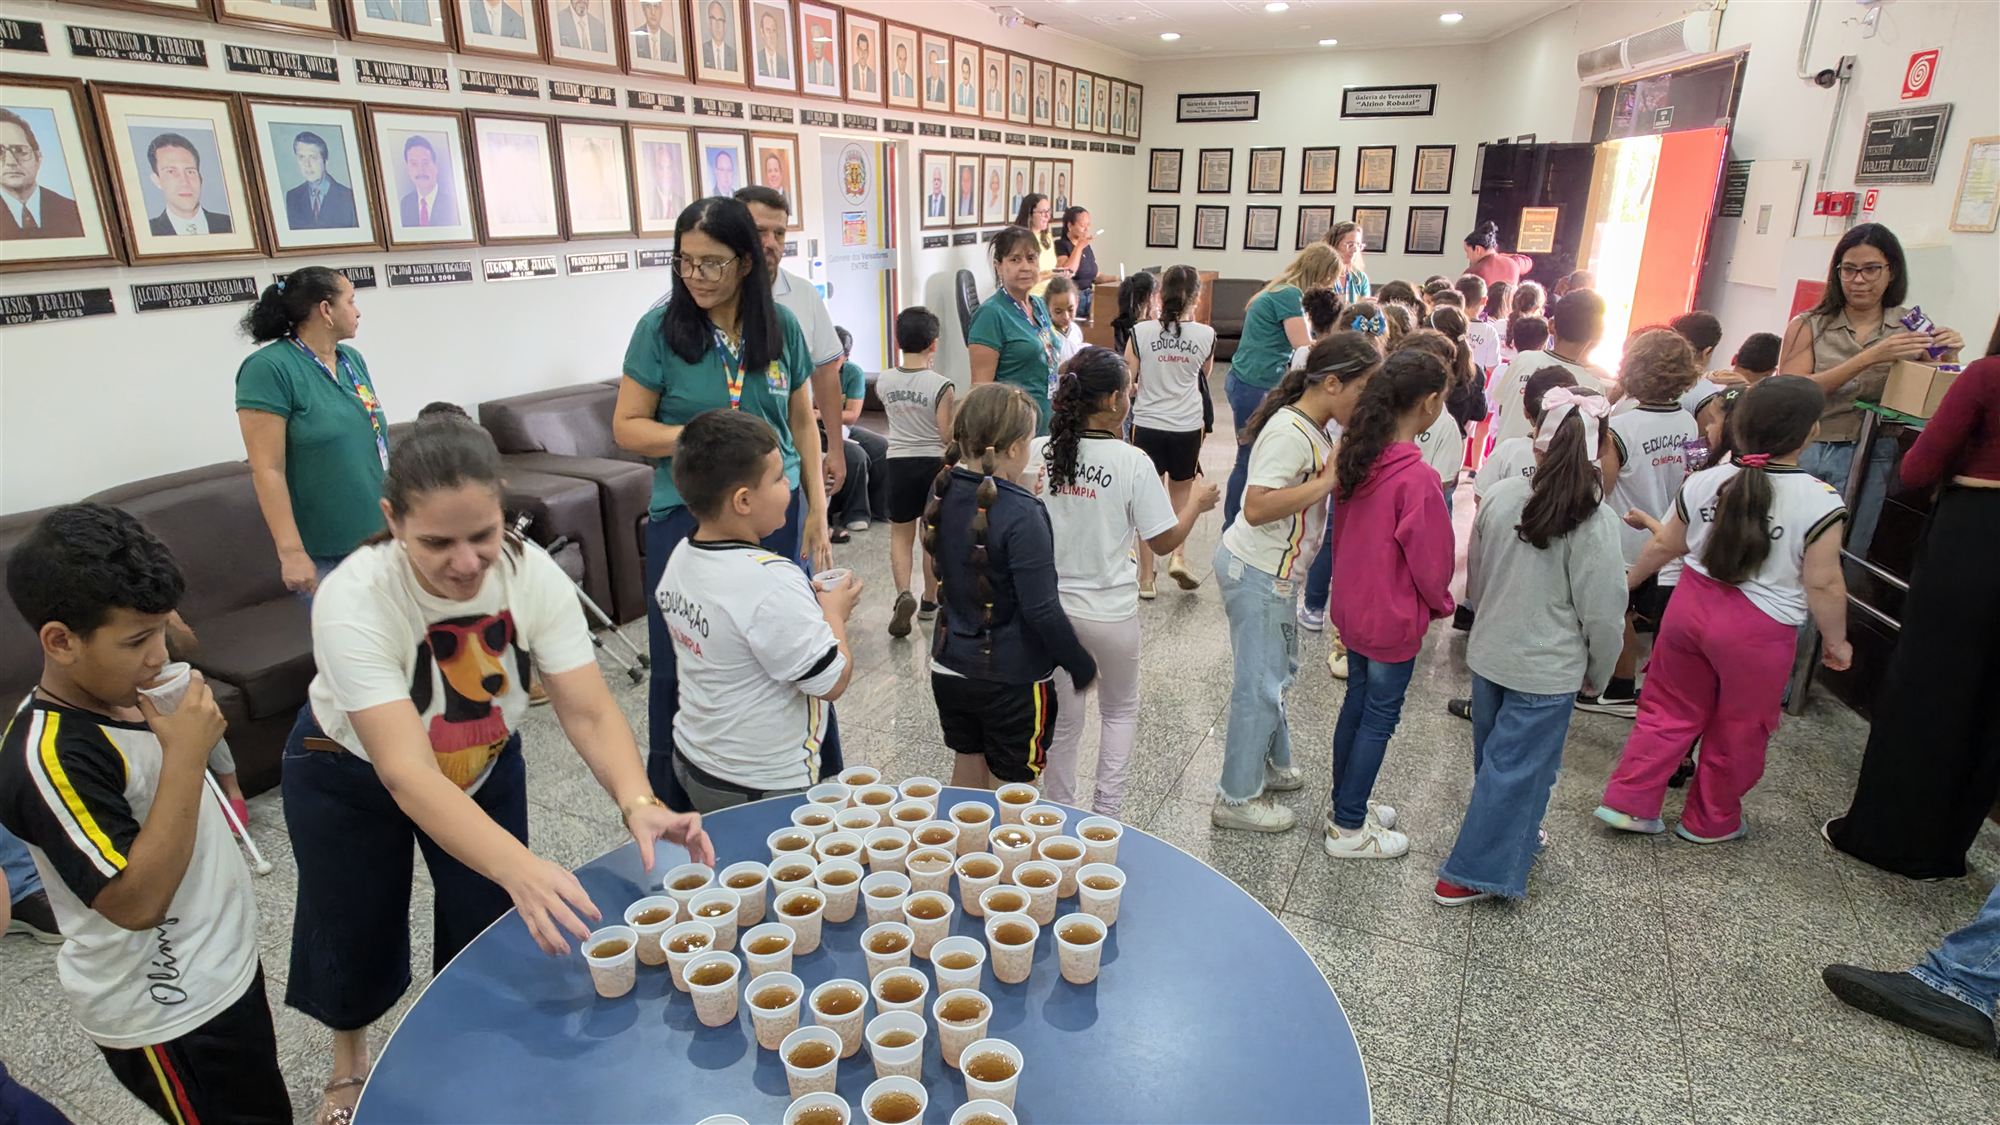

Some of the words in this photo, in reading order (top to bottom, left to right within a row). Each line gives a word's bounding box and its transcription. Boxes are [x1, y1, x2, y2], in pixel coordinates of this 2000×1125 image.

[90, 29, 140, 51] FRANCISCO
[157, 36, 200, 58] FERREIRA
[136, 285, 172, 304] ALCIDES
[171, 282, 208, 300] BECERRA
[207, 279, 244, 296] CANHADA
[1150, 339, 1199, 355] EDUCAÇÃO
[1642, 433, 1689, 455] EDUCAÇÃ
